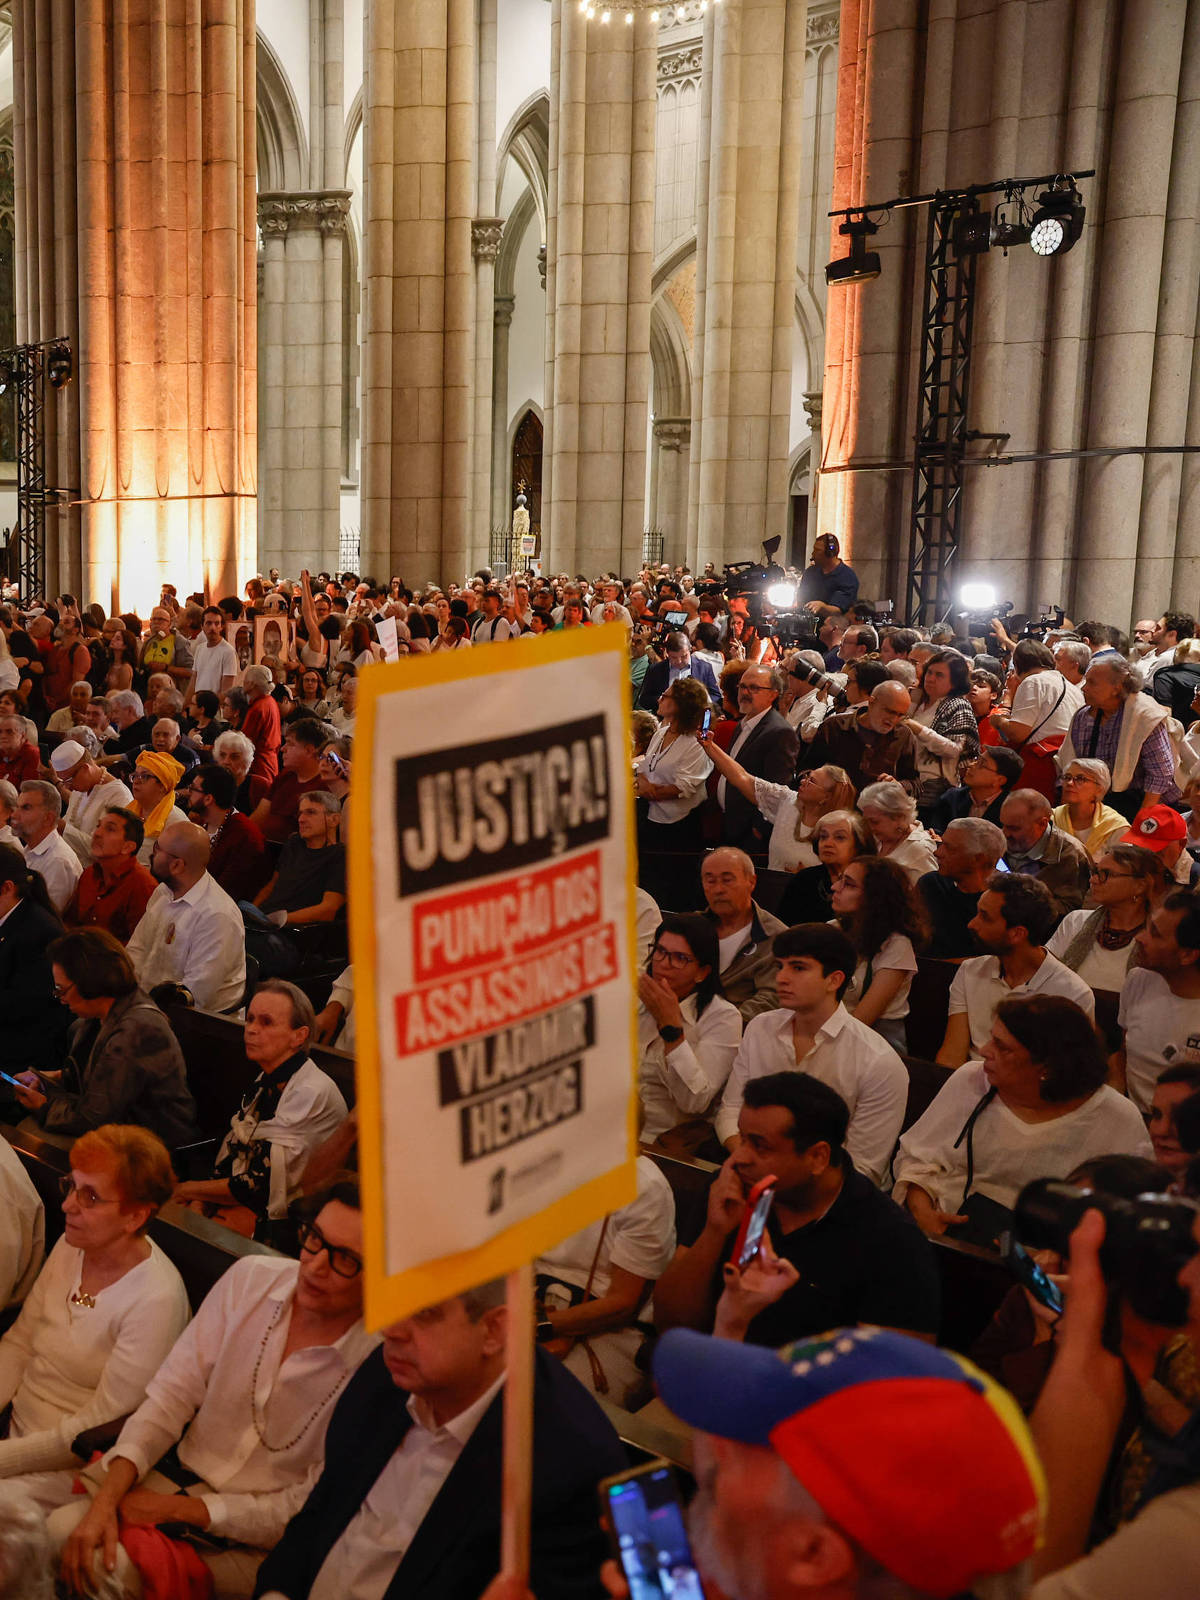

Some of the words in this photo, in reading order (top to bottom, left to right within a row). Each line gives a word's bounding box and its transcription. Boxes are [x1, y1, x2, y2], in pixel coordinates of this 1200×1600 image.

[402, 735, 608, 872] JUSTIÇA!
[419, 877, 553, 971] PUNIÇÃO
[553, 865, 599, 929] DOS
[404, 942, 583, 1050] ASSASSINOS
[581, 928, 615, 985] DE
[452, 999, 585, 1097] VLADIMIR
[470, 1063, 578, 1155] HERZOG
